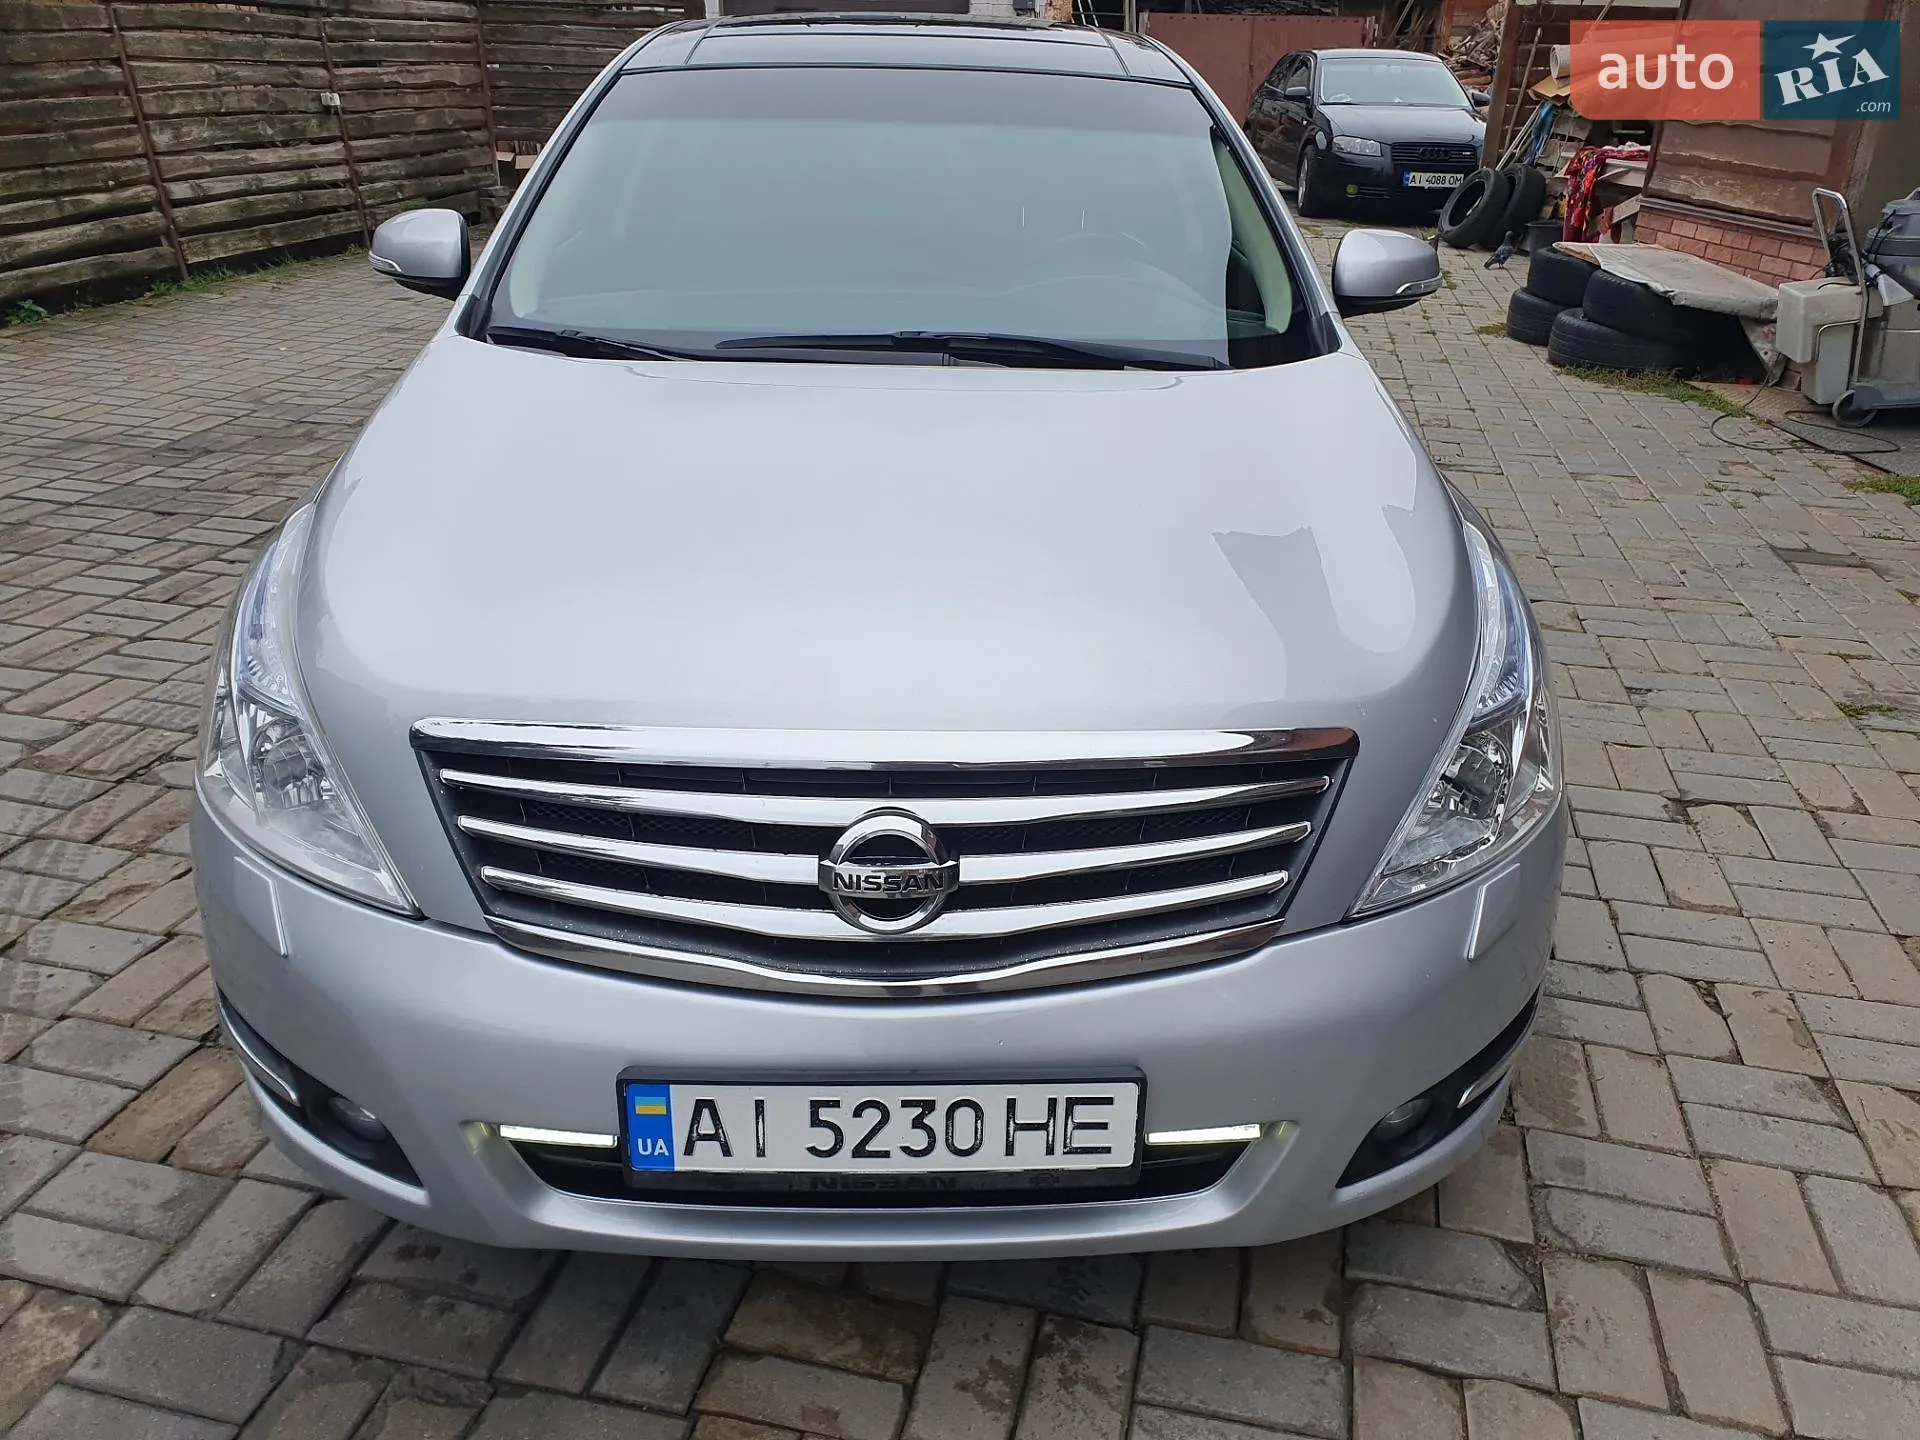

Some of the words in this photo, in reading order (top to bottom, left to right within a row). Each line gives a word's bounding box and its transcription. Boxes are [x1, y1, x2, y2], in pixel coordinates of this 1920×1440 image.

[1410, 174, 1423, 185] AI
[833, 872, 944, 892] NISSAN
[683, 1097, 768, 1159] AI
[804, 1097, 986, 1159] 5230
[1003, 1095, 1116, 1158] HE
[638, 1140, 670, 1157] UA
[810, 1175, 959, 1191] NISSAN
